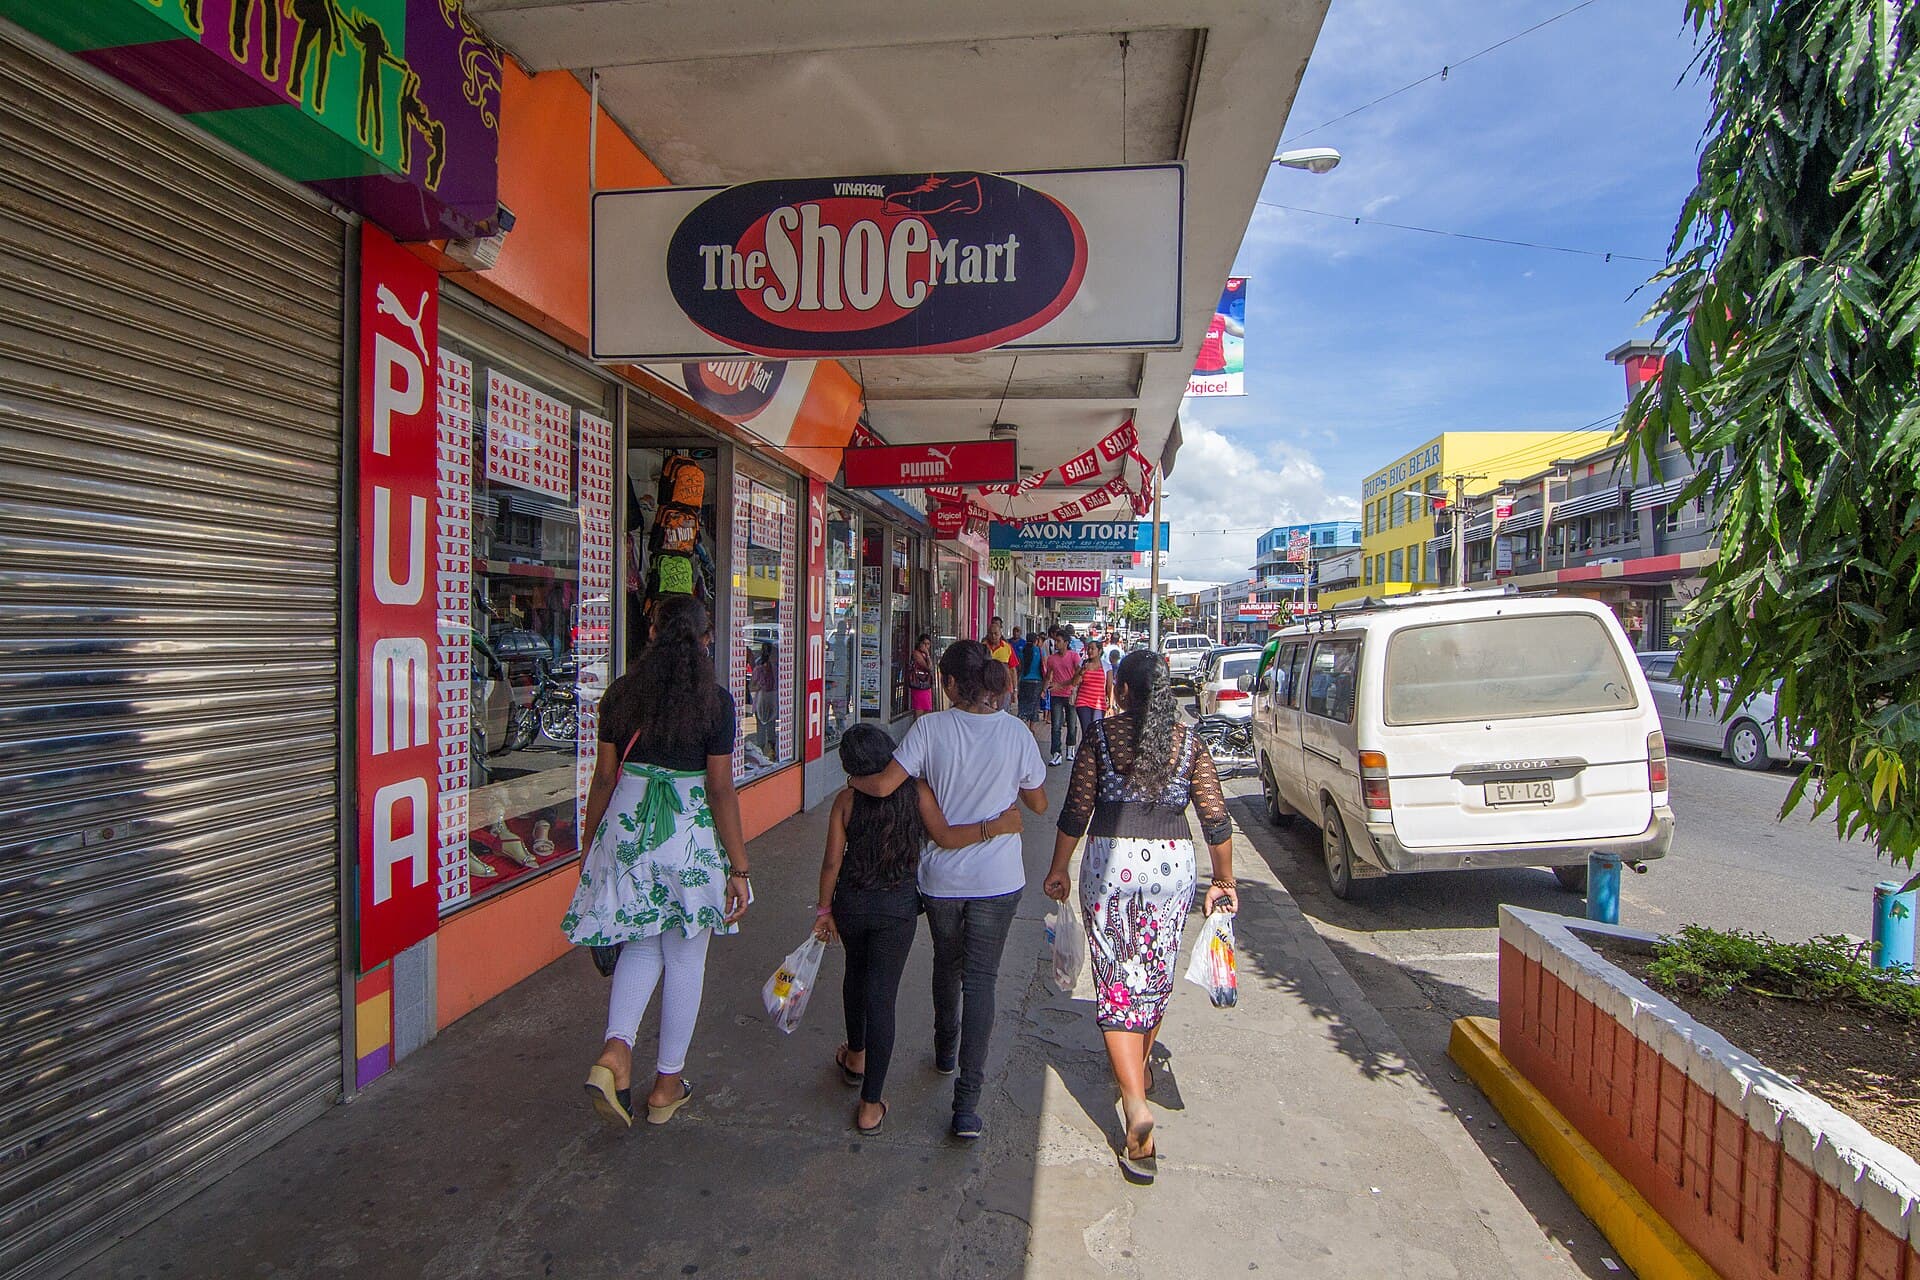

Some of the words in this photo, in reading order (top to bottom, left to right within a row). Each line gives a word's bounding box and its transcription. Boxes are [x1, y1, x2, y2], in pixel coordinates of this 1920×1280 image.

[833, 182, 885, 198] VINAYAK
[699, 244, 767, 291] The
[764, 203, 929, 312] Shoe
[928, 233, 1020, 287] Mart
[490, 378, 530, 405] SALE
[534, 398, 569, 421] SALE
[490, 394, 529, 419] SALE
[534, 413, 569, 436] SALE
[490, 411, 529, 435] SALE
[534, 428, 569, 450] SALE
[582, 418, 612, 437] SALE
[582, 432, 612, 450] SALE
[1104, 426, 1133, 455] SALE
[489, 444, 529, 468] SALE
[534, 459, 569, 481] SALE
[534, 445, 569, 466] SALE
[582, 446, 612, 464] SALE
[582, 462, 612, 478] SALE
[900, 461, 945, 478] PUMA
[1066, 455, 1096, 479] SALE
[1364, 473, 1387, 500] RUPS
[1389, 462, 1407, 487] BIG
[1409, 444, 1440, 477] BEAR
[489, 461, 529, 484] SALE
[534, 475, 569, 495] SALE
[582, 475, 612, 492] SALE
[582, 489, 612, 505] SALE
[1086, 491, 1107, 508] SALE
[937, 511, 962, 521] Digicel
[967, 505, 987, 518] SALE
[1058, 504, 1081, 520] SALE
[582, 532, 612, 546] SALE
[1018, 524, 1072, 539] AVON
[1078, 524, 1139, 540] STORE
[582, 548, 612, 560] SALE
[582, 562, 610, 574] SALE
[582, 576, 610, 588] SALE
[1036, 576, 1100, 592] CHEMIST
[371, 332, 430, 906] PUMA
[809, 516, 823, 740] PUMA
[1495, 760, 1548, 769] TOYOTA
